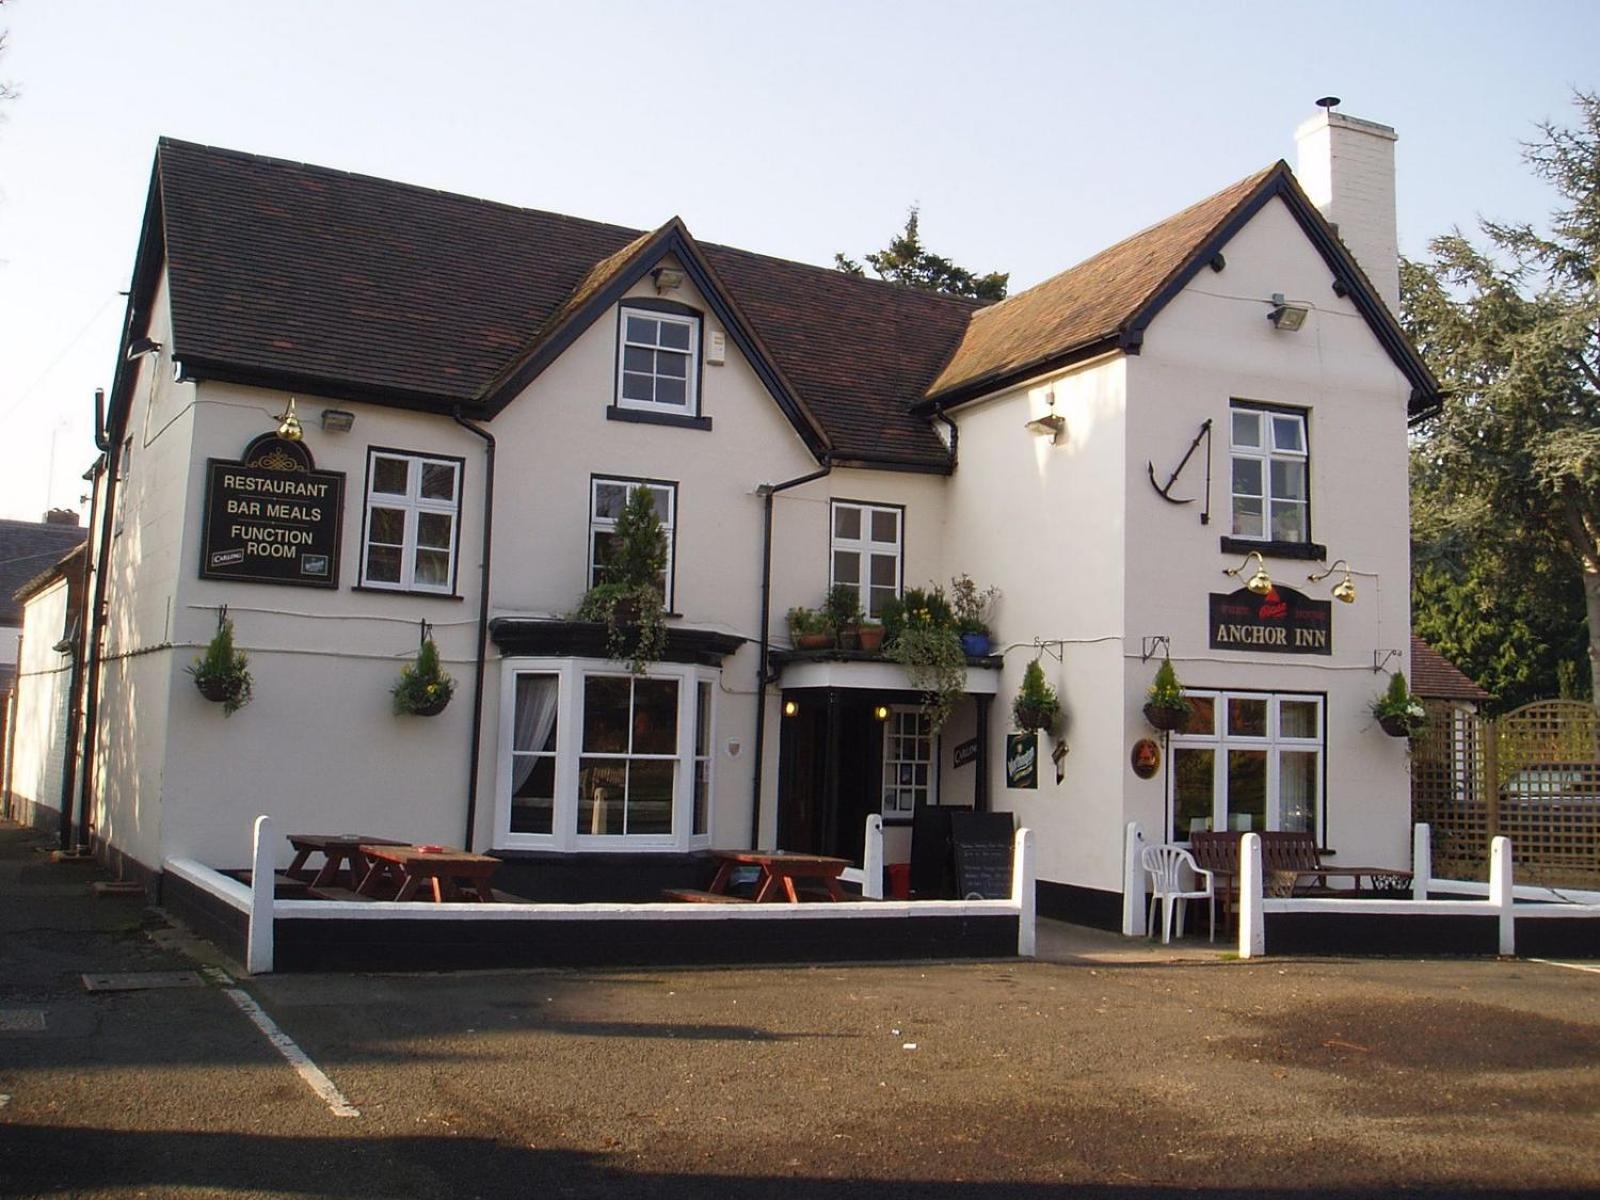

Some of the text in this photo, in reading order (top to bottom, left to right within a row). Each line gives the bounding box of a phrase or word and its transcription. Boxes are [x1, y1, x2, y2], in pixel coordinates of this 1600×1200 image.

[224, 475, 328, 497] RESTAURANT
[227, 500, 321, 521] BAR MEALS
[231, 525, 313, 545] FUNCTION
[247, 542, 296, 558] ROOM
[1217, 624, 1326, 647] ANCHOR INN
